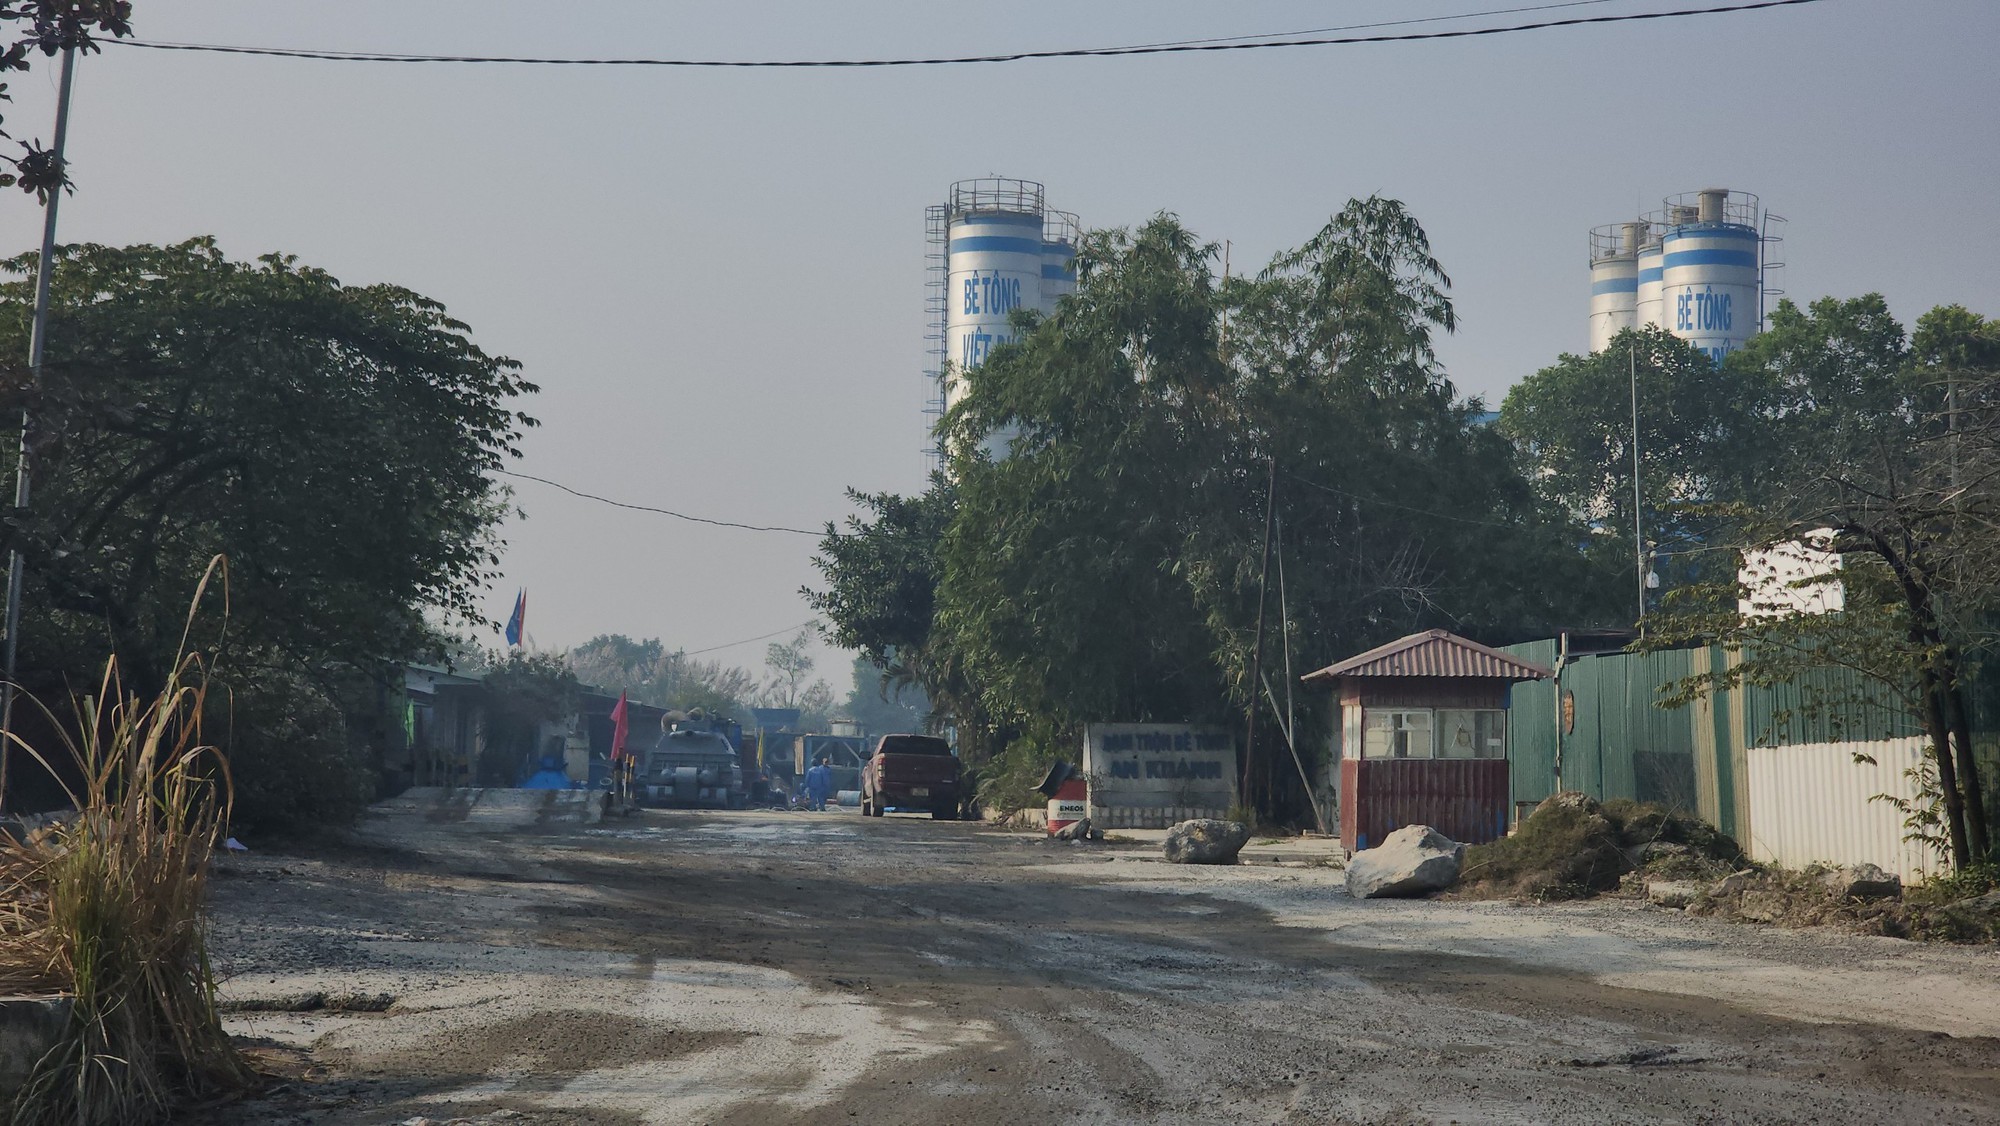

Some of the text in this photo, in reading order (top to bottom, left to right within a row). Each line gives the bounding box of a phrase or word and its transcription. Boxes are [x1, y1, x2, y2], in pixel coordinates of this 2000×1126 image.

[964, 269, 1021, 315] BÊ TÔNG
[1677, 285, 1732, 331] BÊ TÔNG
